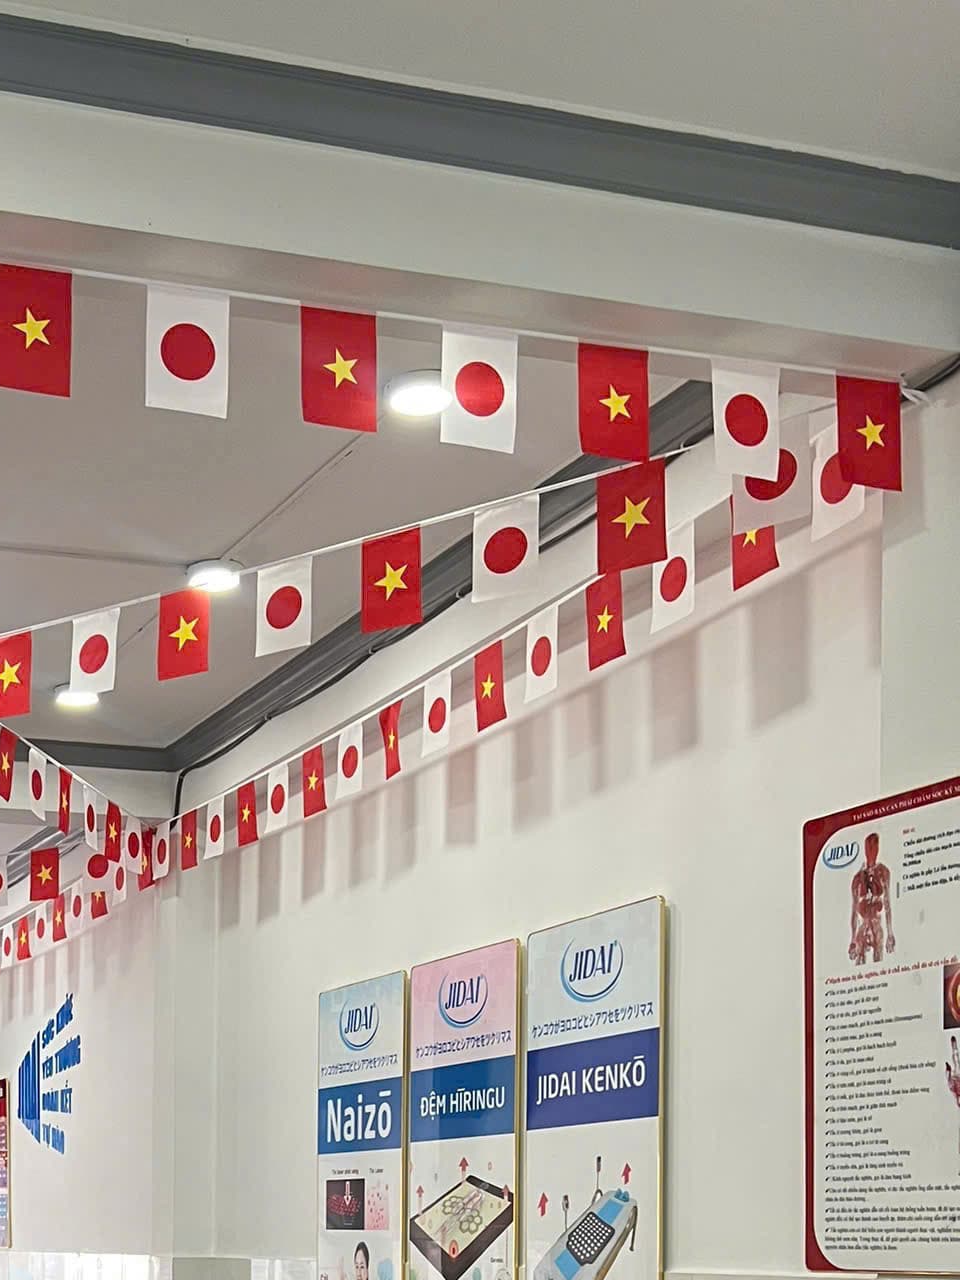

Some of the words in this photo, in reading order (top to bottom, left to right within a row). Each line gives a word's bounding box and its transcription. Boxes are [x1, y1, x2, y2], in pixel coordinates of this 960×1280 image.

[569, 942, 614, 982] JIDAI
[445, 976, 481, 1010] JIDAI
[344, 1005, 373, 1034] JIDAI
[536, 1070, 576, 1105] JIDAI
[582, 1055, 646, 1095] KENKŌ
[327, 1090, 392, 1143] Naizō
[420, 1088, 447, 1120] ĐỆM
[449, 1086, 505, 1114] HĪRINGU
